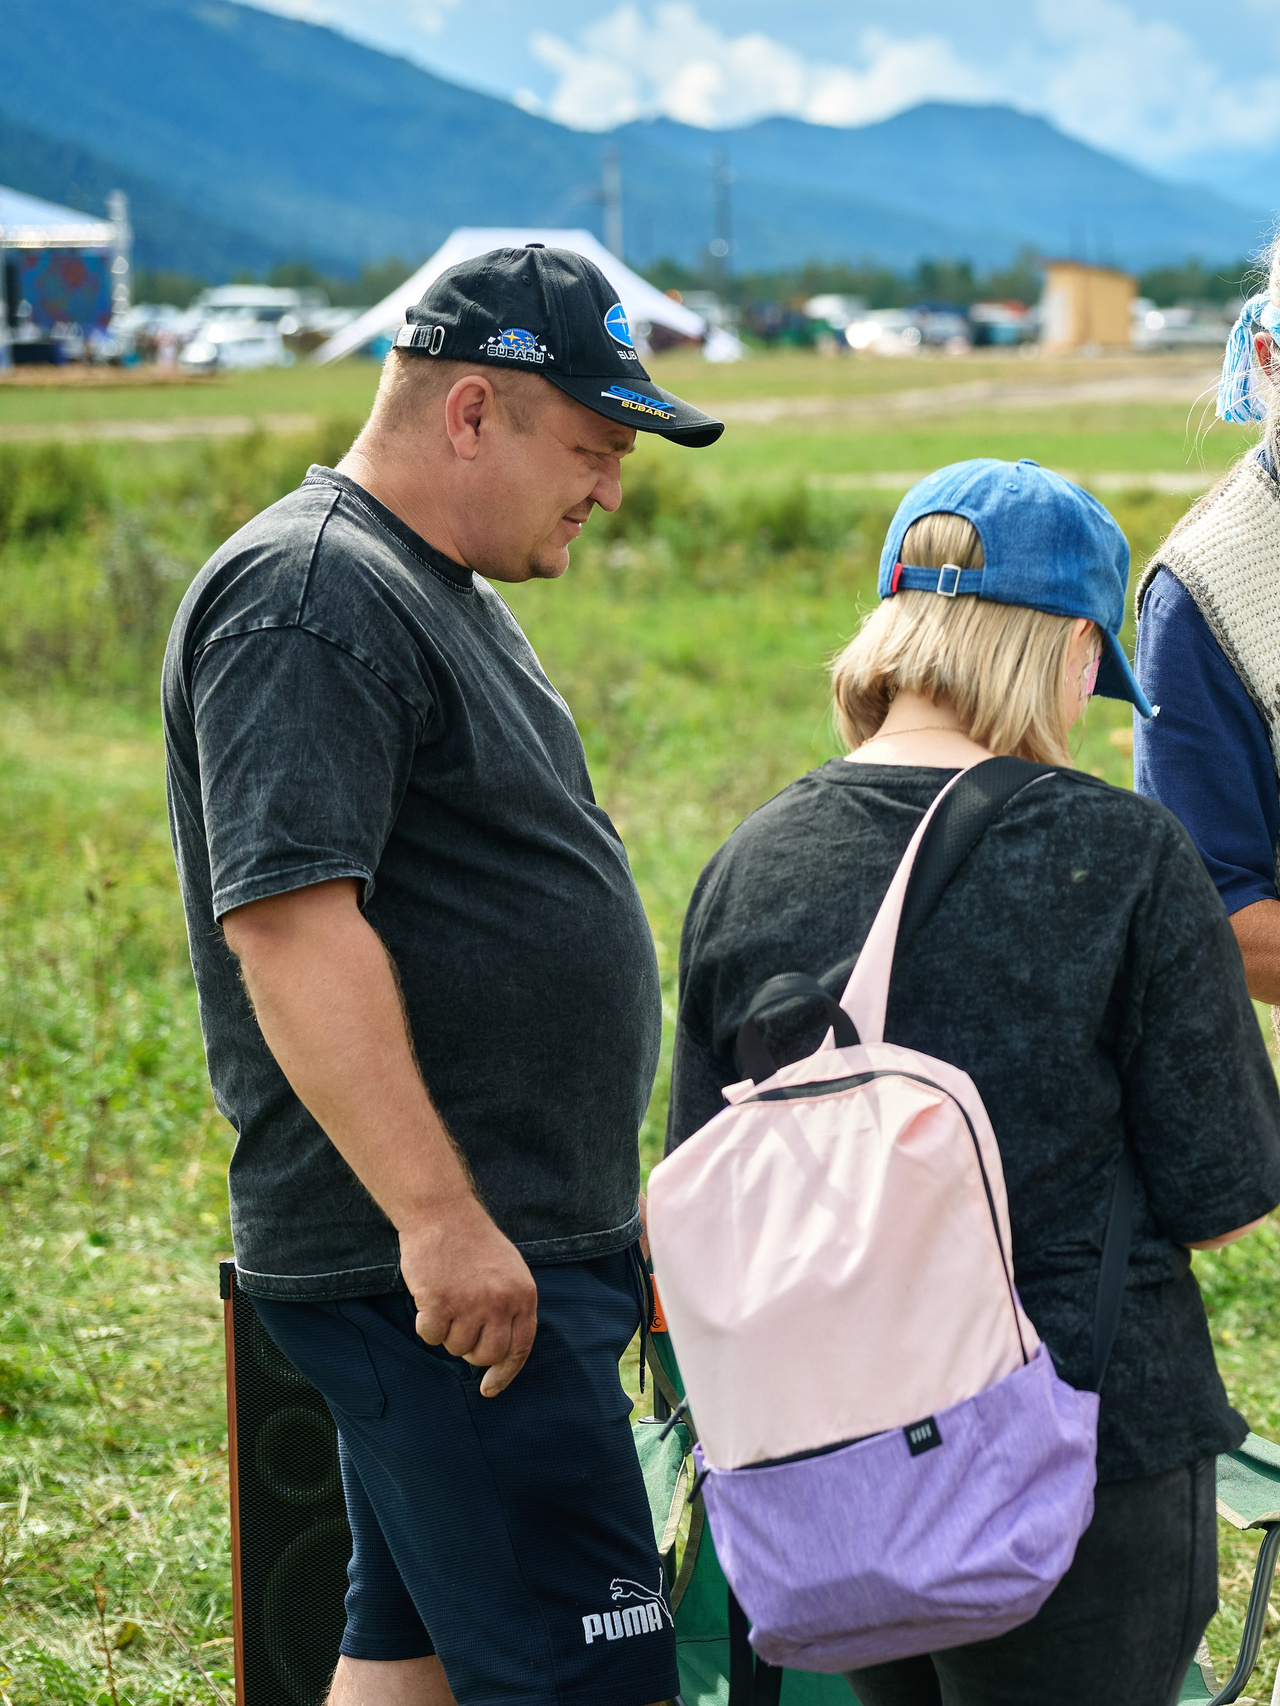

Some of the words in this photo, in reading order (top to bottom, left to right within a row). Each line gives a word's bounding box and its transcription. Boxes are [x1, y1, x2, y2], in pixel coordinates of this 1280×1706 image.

[487, 344, 545, 364] SUBARU
[621, 400, 670, 420] SUBARU
[582, 1602, 663, 1645] PUMA
